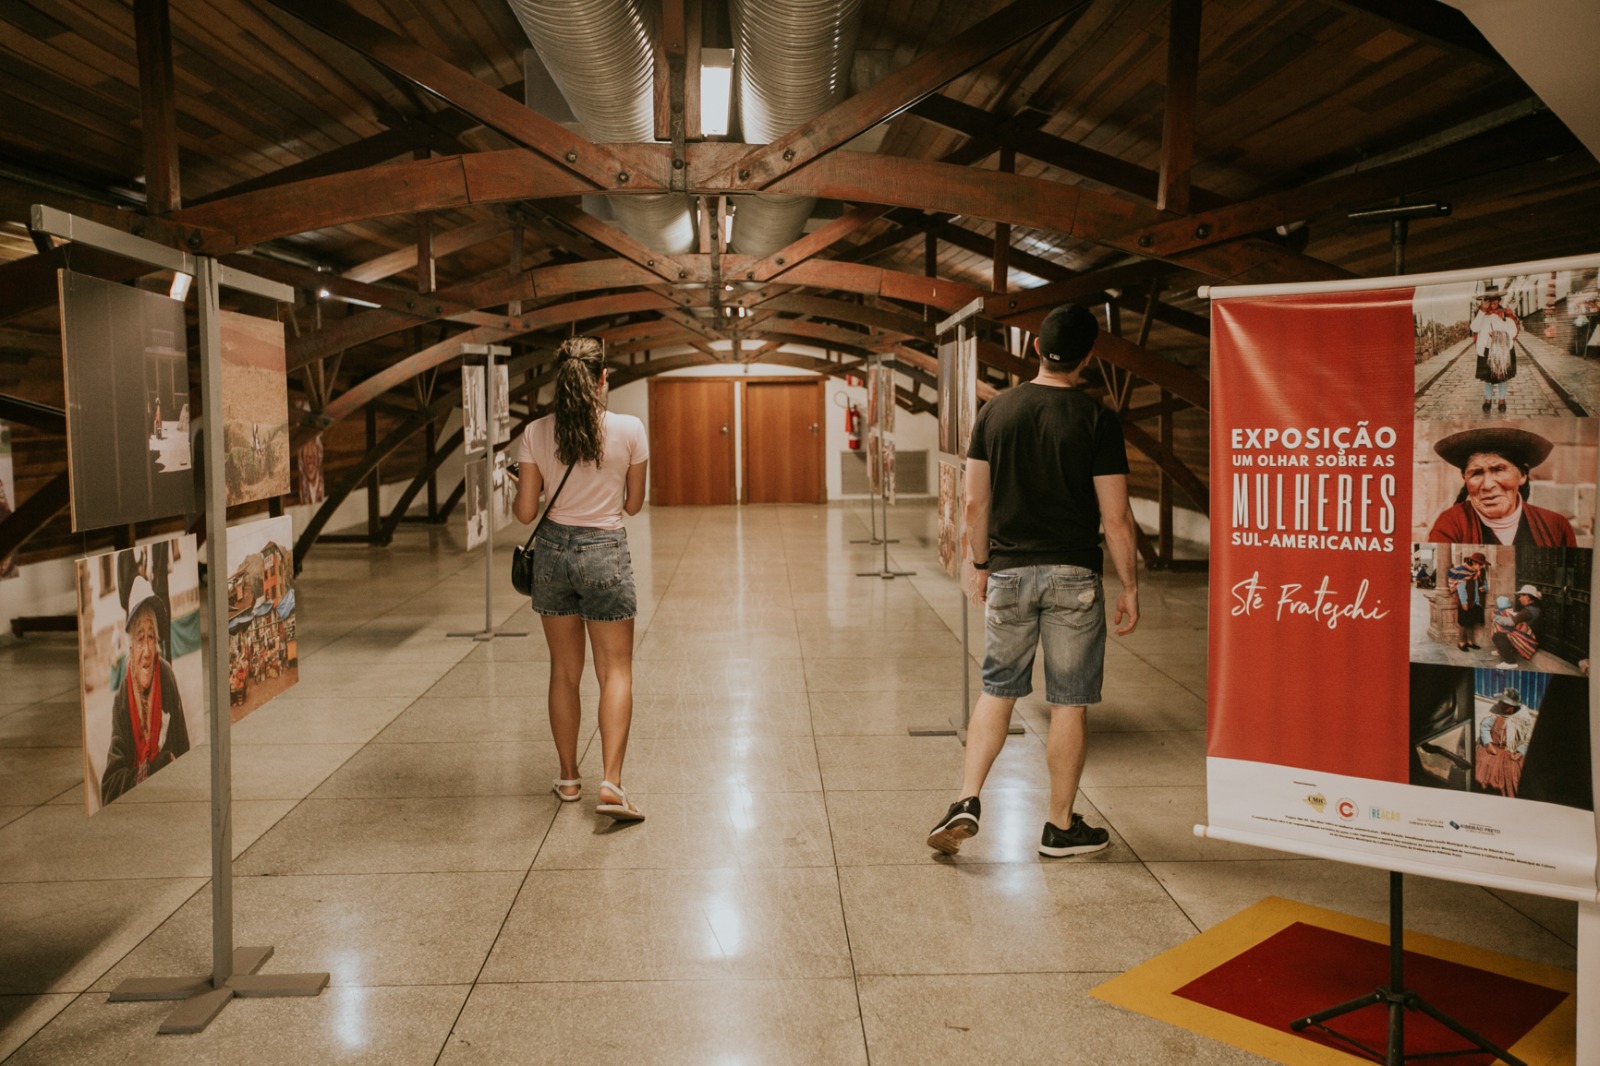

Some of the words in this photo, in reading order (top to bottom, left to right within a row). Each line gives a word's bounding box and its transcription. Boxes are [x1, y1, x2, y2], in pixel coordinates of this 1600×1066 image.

[1231, 420, 1397, 456] EXPOSIÇÃO
[1232, 454, 1253, 467] UM
[1257, 454, 1309, 467] OLHAR
[1315, 454, 1367, 467] SOBRE
[1373, 454, 1395, 467] AS
[1231, 473, 1396, 535] MULHERES
[1231, 532, 1394, 552] SUL-AMERICANAS
[1276, 575, 1390, 629] Frateschi
